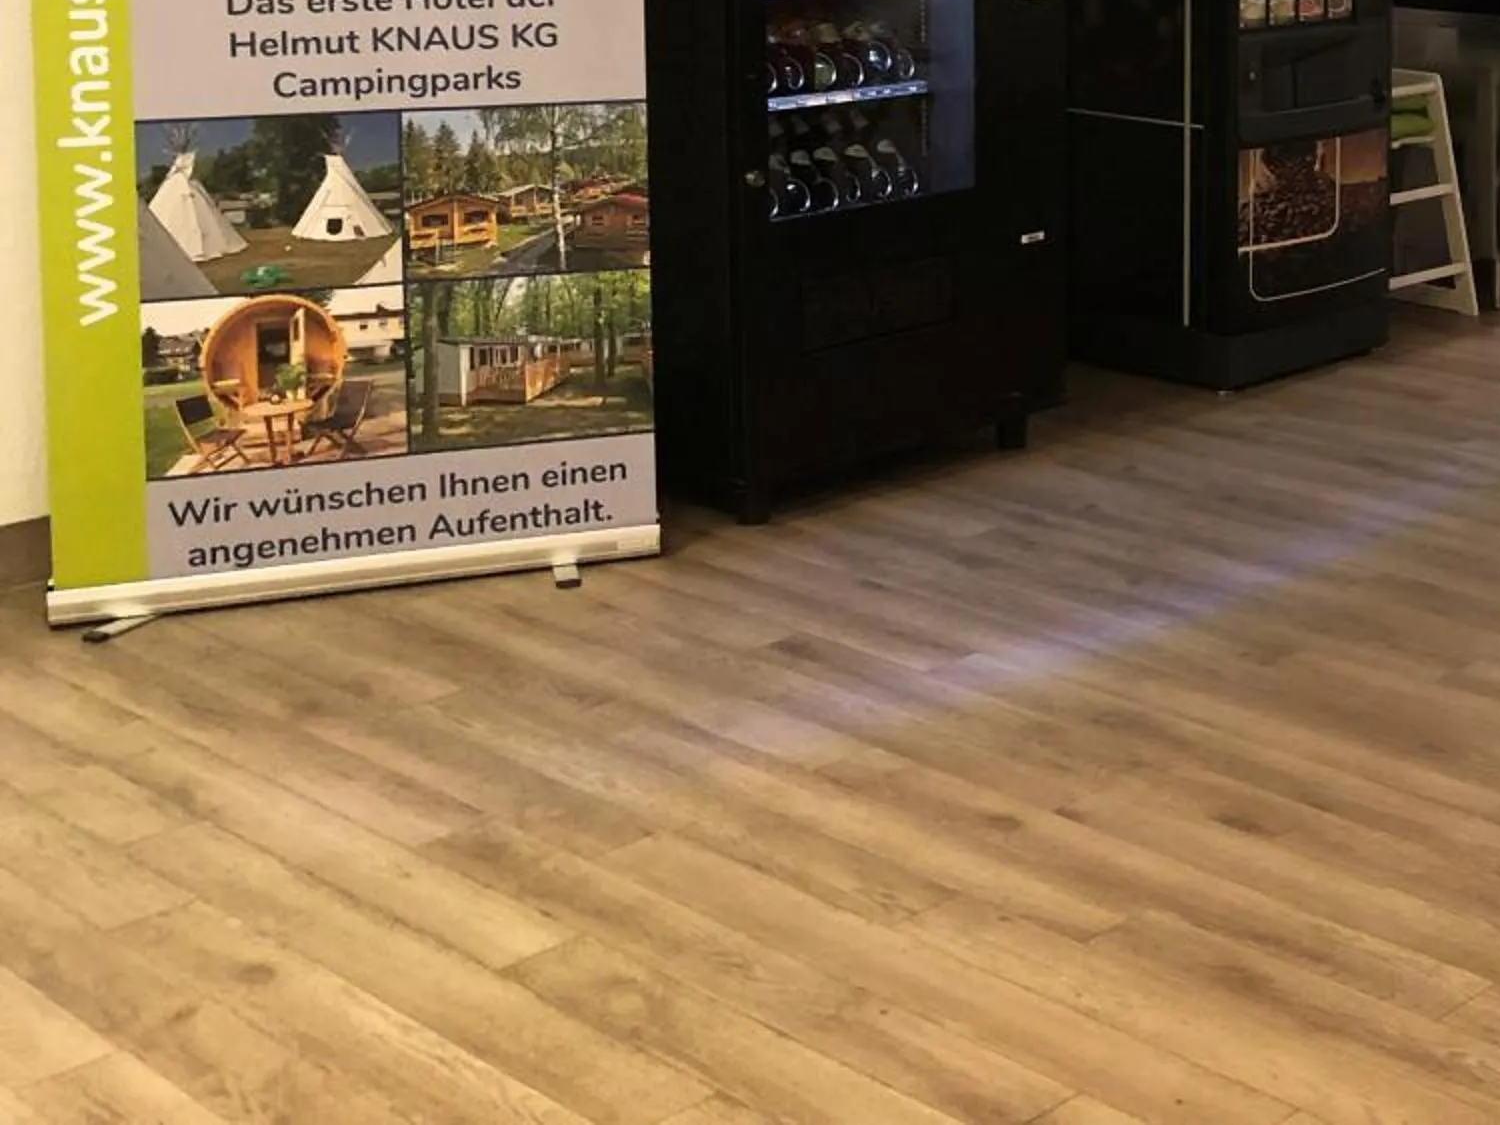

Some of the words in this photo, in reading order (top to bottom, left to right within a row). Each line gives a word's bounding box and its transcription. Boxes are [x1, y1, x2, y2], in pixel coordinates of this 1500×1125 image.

[229, 27, 360, 58] Helmut
[371, 24, 500, 53] KNAUS
[511, 22, 558, 49] KG
[273, 64, 522, 101] Campingparks
[168, 497, 238, 528] Wir
[248, 482, 427, 520] wünschen
[439, 471, 530, 499] Ihnen
[542, 459, 628, 488] einen
[187, 522, 417, 569] angenehmen
[429, 497, 613, 541] Aufenthalt.
